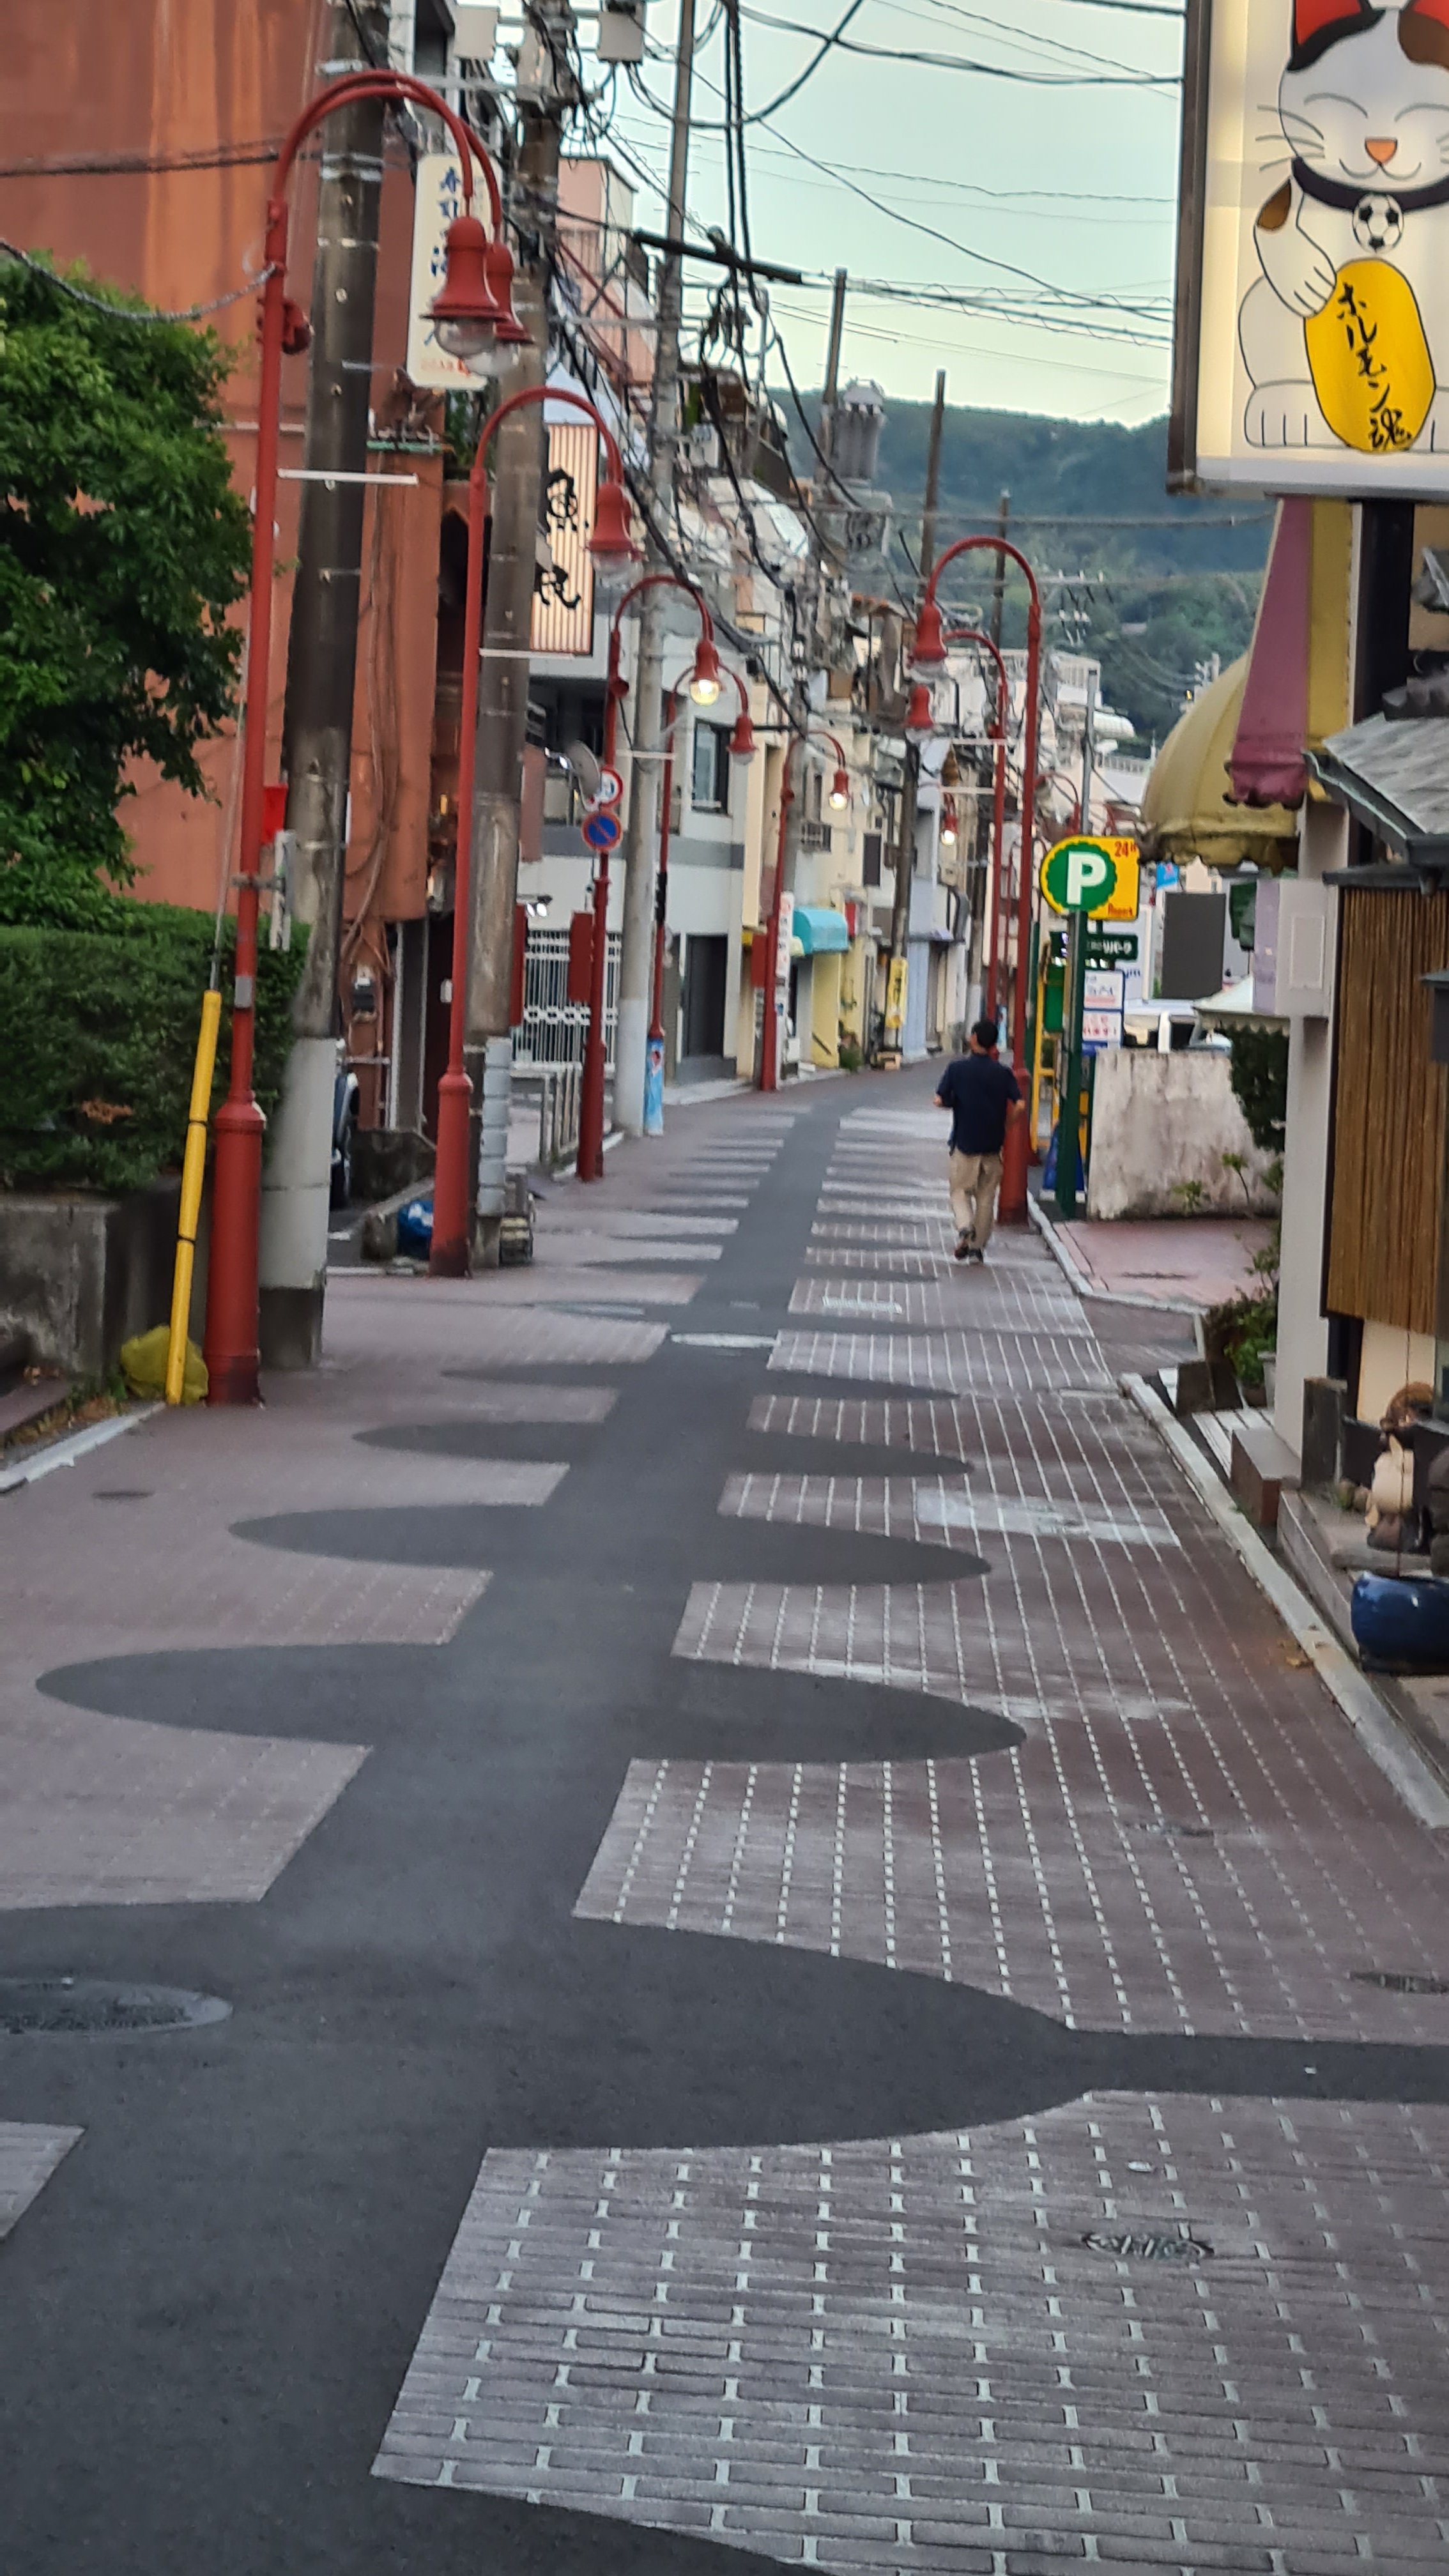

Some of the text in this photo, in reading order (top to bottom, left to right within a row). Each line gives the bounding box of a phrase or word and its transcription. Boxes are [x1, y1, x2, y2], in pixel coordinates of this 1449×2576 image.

[1337, 281, 1412, 451] ホルモン魂
[1066, 851, 1107, 905] P
